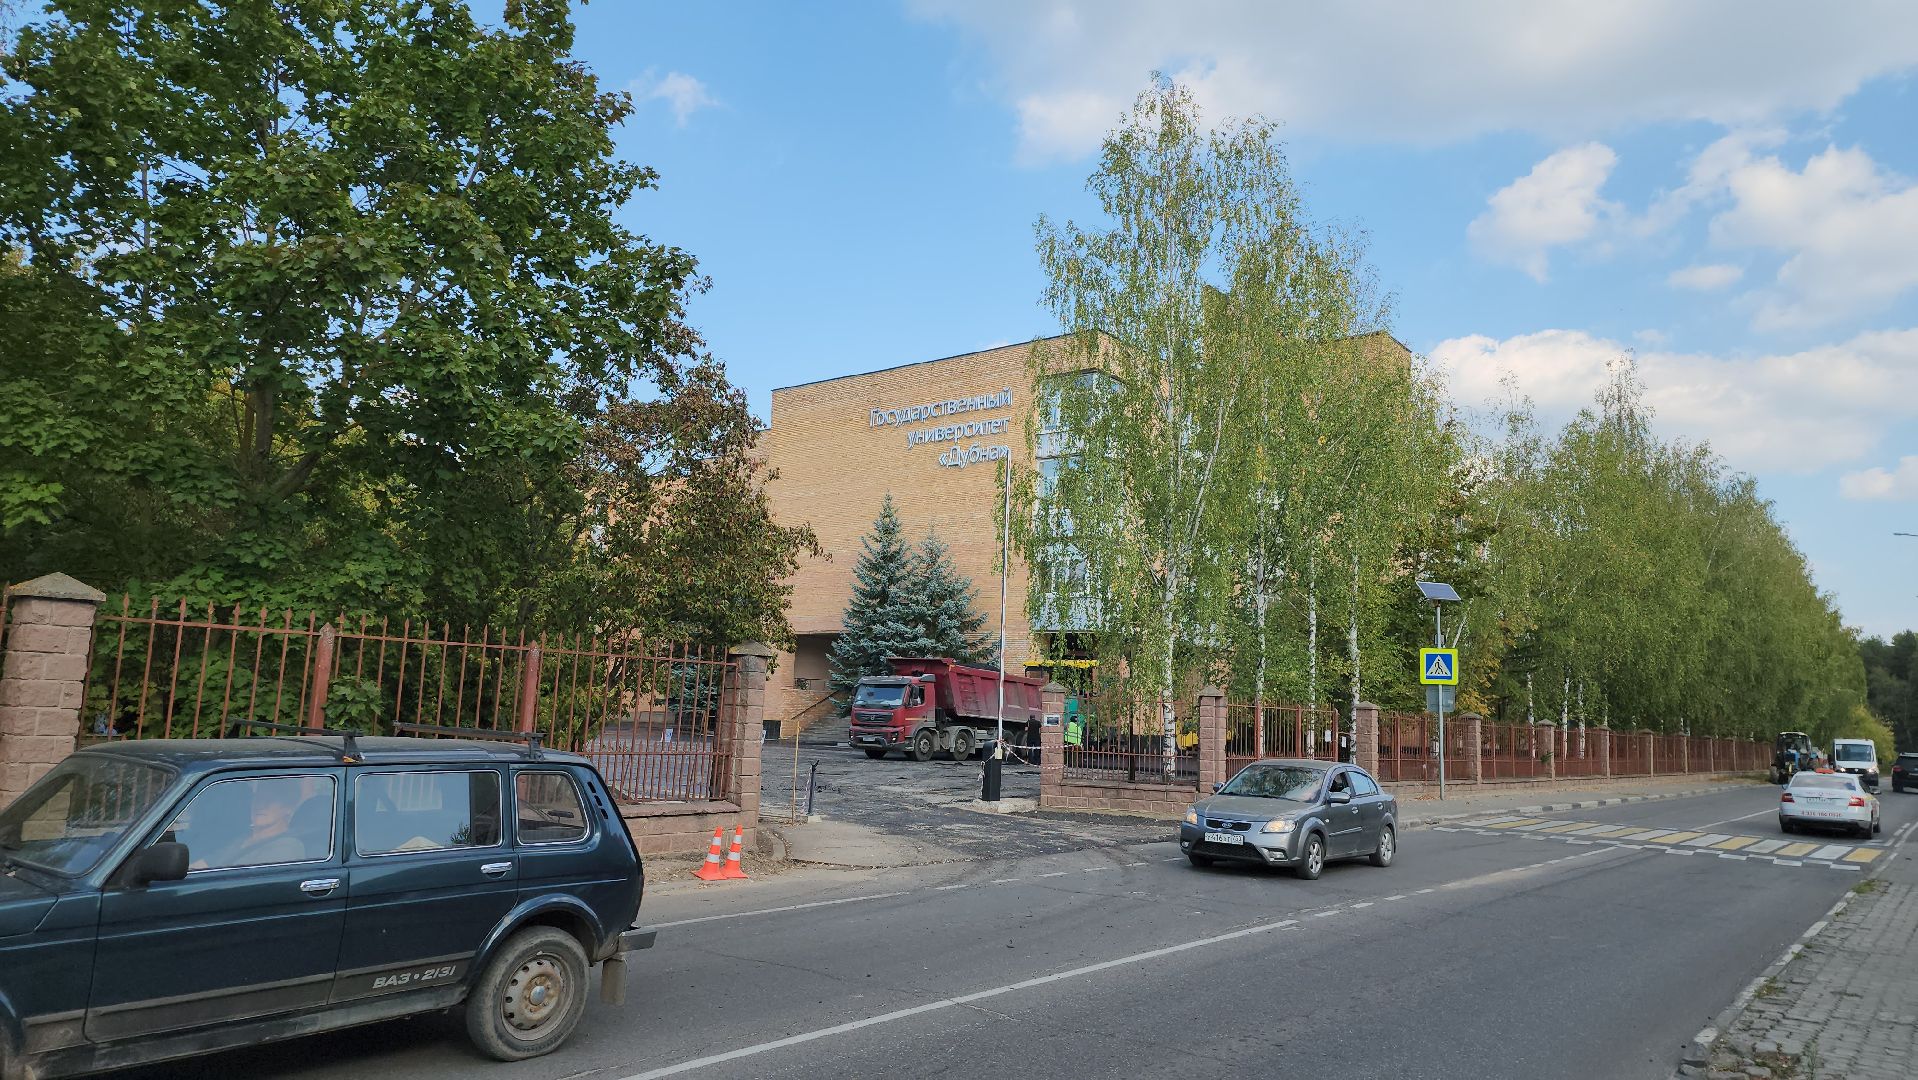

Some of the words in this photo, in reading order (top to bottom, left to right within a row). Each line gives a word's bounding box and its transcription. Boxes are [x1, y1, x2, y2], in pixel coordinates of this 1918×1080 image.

[869, 386, 1014, 428] Государственный
[907, 417, 1012, 449] университет
[939, 441, 1010, 469] «Дубна»
[372, 972, 411, 989] ВАЗ
[421, 965, 456, 980] 2131
